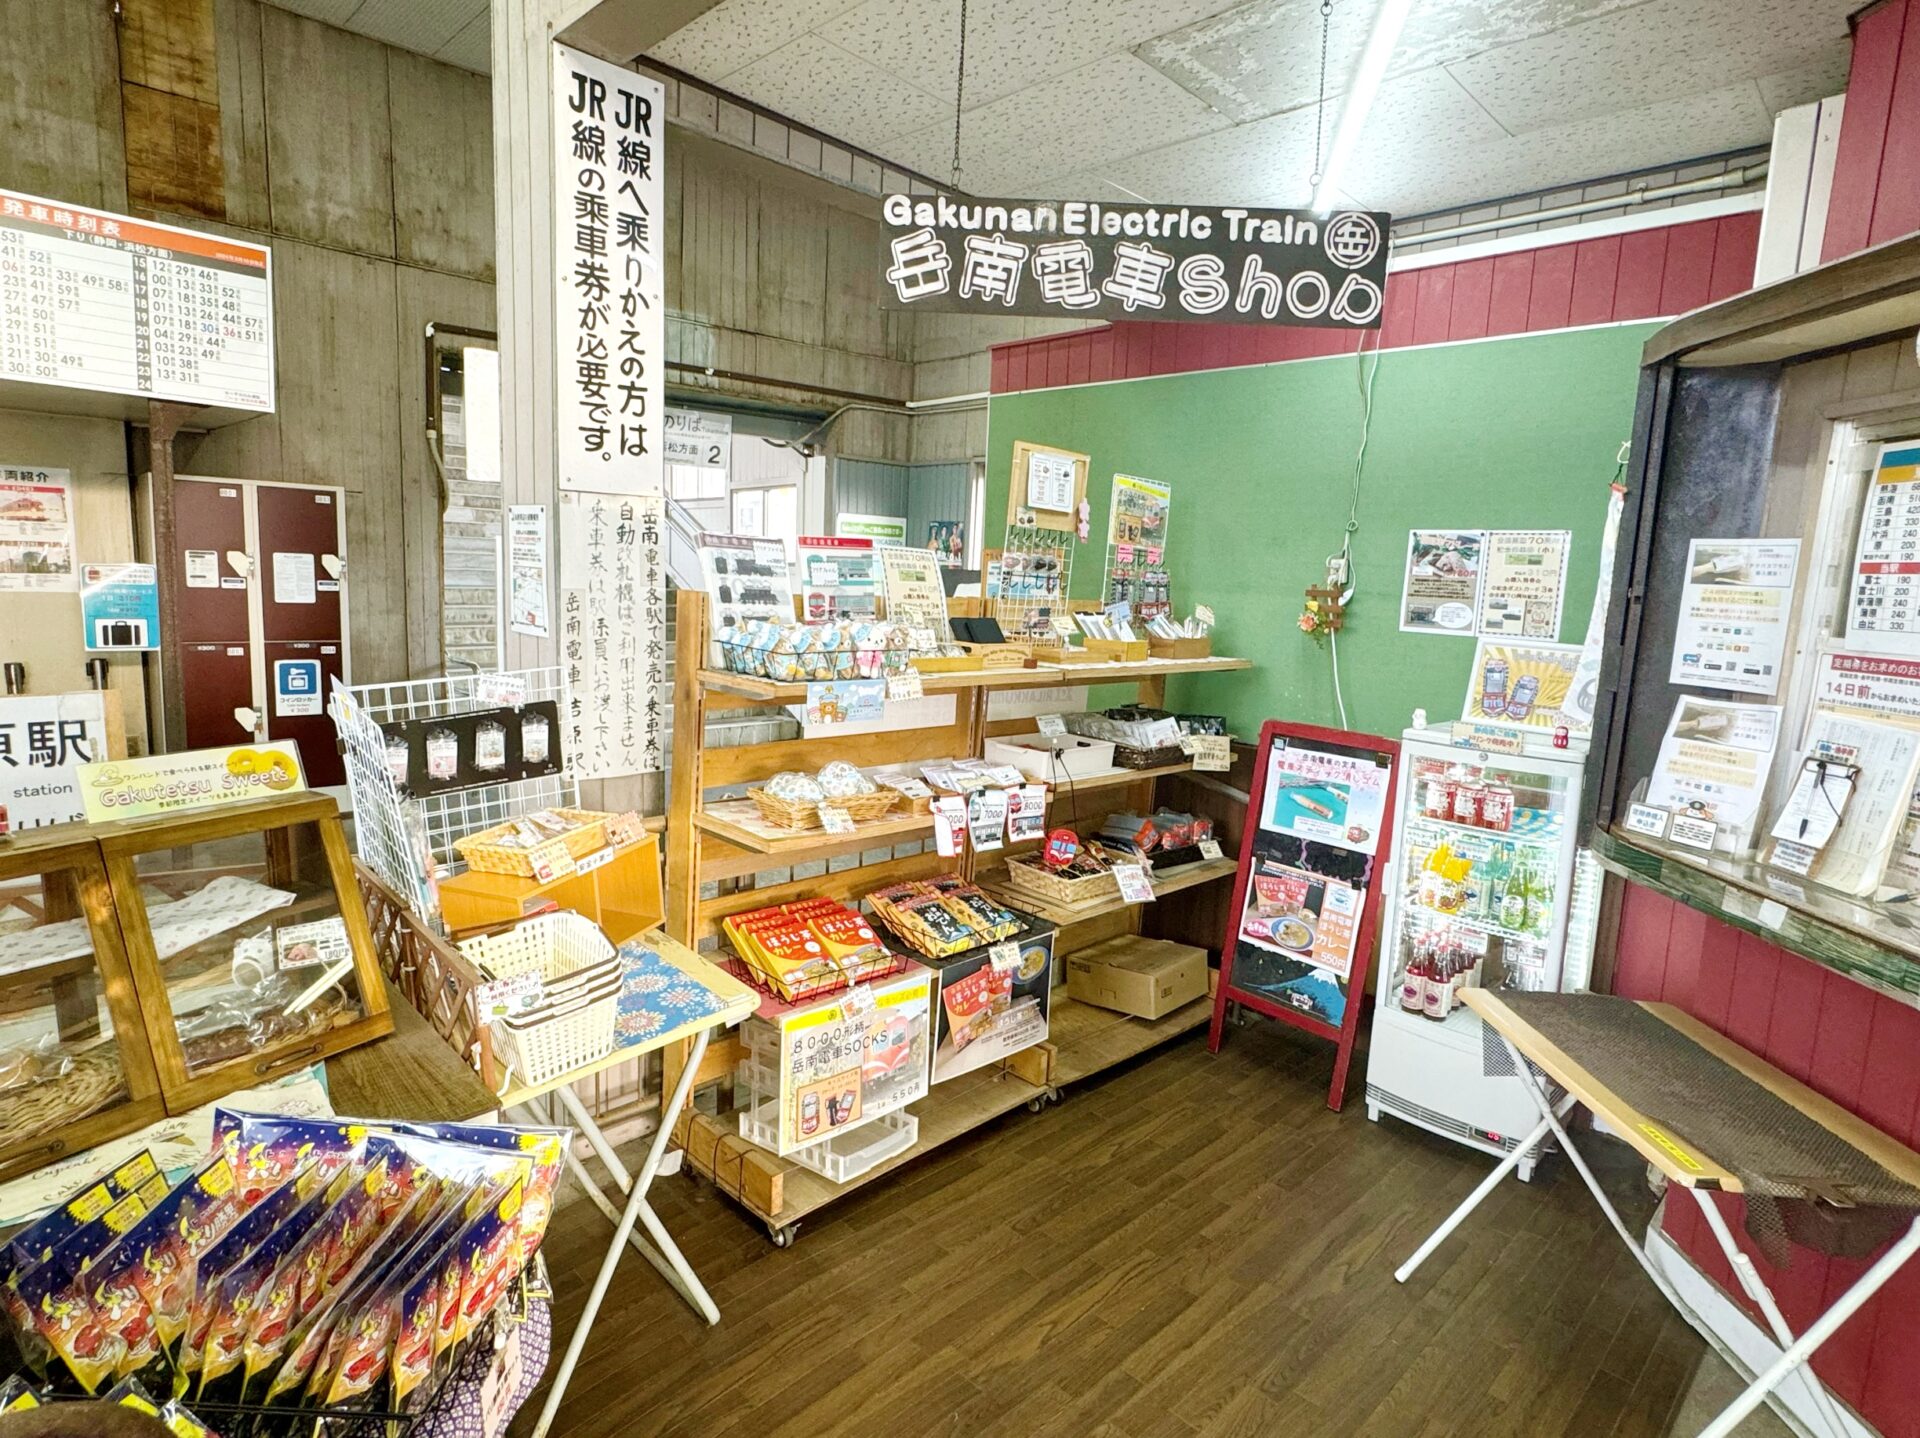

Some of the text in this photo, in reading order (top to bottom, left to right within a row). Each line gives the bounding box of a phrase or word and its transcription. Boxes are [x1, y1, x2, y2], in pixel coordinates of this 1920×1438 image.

[3, 197, 121, 238] 発車時刻表
[884, 195, 1317, 245] Gakunan Electric Train
[1, 230, 17, 243] 53
[1, 246, 45, 263] 41 52
[134, 257, 212, 281] 15 12 29 46
[568, 70, 612, 462] JR線の乗車券が必要です。
[614, 87, 653, 458] JR線へ乗りかえの方は
[2, 260, 122, 291] 06 23 33 49 58
[886, 227, 1383, 325] 岳南電車Shop
[3, 274, 72, 296] 23 41 59
[134, 271, 235, 298] 16 00 13 33 52
[4, 289, 73, 310] 27 47 57
[135, 285, 235, 311] 17 07 18 35 48
[5, 304, 48, 321] 34 50
[135, 298, 257, 328] 18 01 13 26 44 57
[6, 318, 47, 335] 29 51
[135, 312, 256, 341] 19 07 18 30 36 51
[7, 333, 48, 349] 31 51
[136, 326, 219, 347] 20 04 29 44
[7, 347, 76, 366] 21 30 49
[136, 340, 215, 359] 21 03 23 49
[8, 361, 51, 377] 30 50
[137, 353, 192, 370] 22 10 38
[138, 366, 192, 382] 23 13 31
[138, 380, 152, 390] 24
[664, 441, 721, 464] 松方面 2
[0, 470, 49, 483] 両紹介
[1875, 507, 1892, 516] 三島
[1905, 518, 1920, 526] 330
[1903, 529, 1917, 538] 240
[1901, 541, 1916, 550] 200
[1900, 553, 1914, 561] 190
[1865, 575, 1911, 585] 富士 190
[1859, 586, 1910, 596] 富士川 200
[1893, 599, 1908, 608] 240
[1891, 610, 1906, 619] 240
[1889, 622, 1905, 631] 330
[1832, 657, 1920, 677] 定期券をお求めのお
[13, 782, 73, 799] station
[100, 767, 290, 808] Gakutetsu Sweets
[984, 810, 1003, 819] 7000
[1023, 801, 1043, 811] 8000
[822, 916, 867, 934] ほうじ茶
[766, 929, 815, 949] ほうじ茶
[829, 931, 855, 942] カレー
[1316, 935, 1349, 949] カレー
[773, 944, 802, 957] カレー
[1320, 951, 1345, 970] 550円
[952, 977, 988, 1006] ほうじ茶
